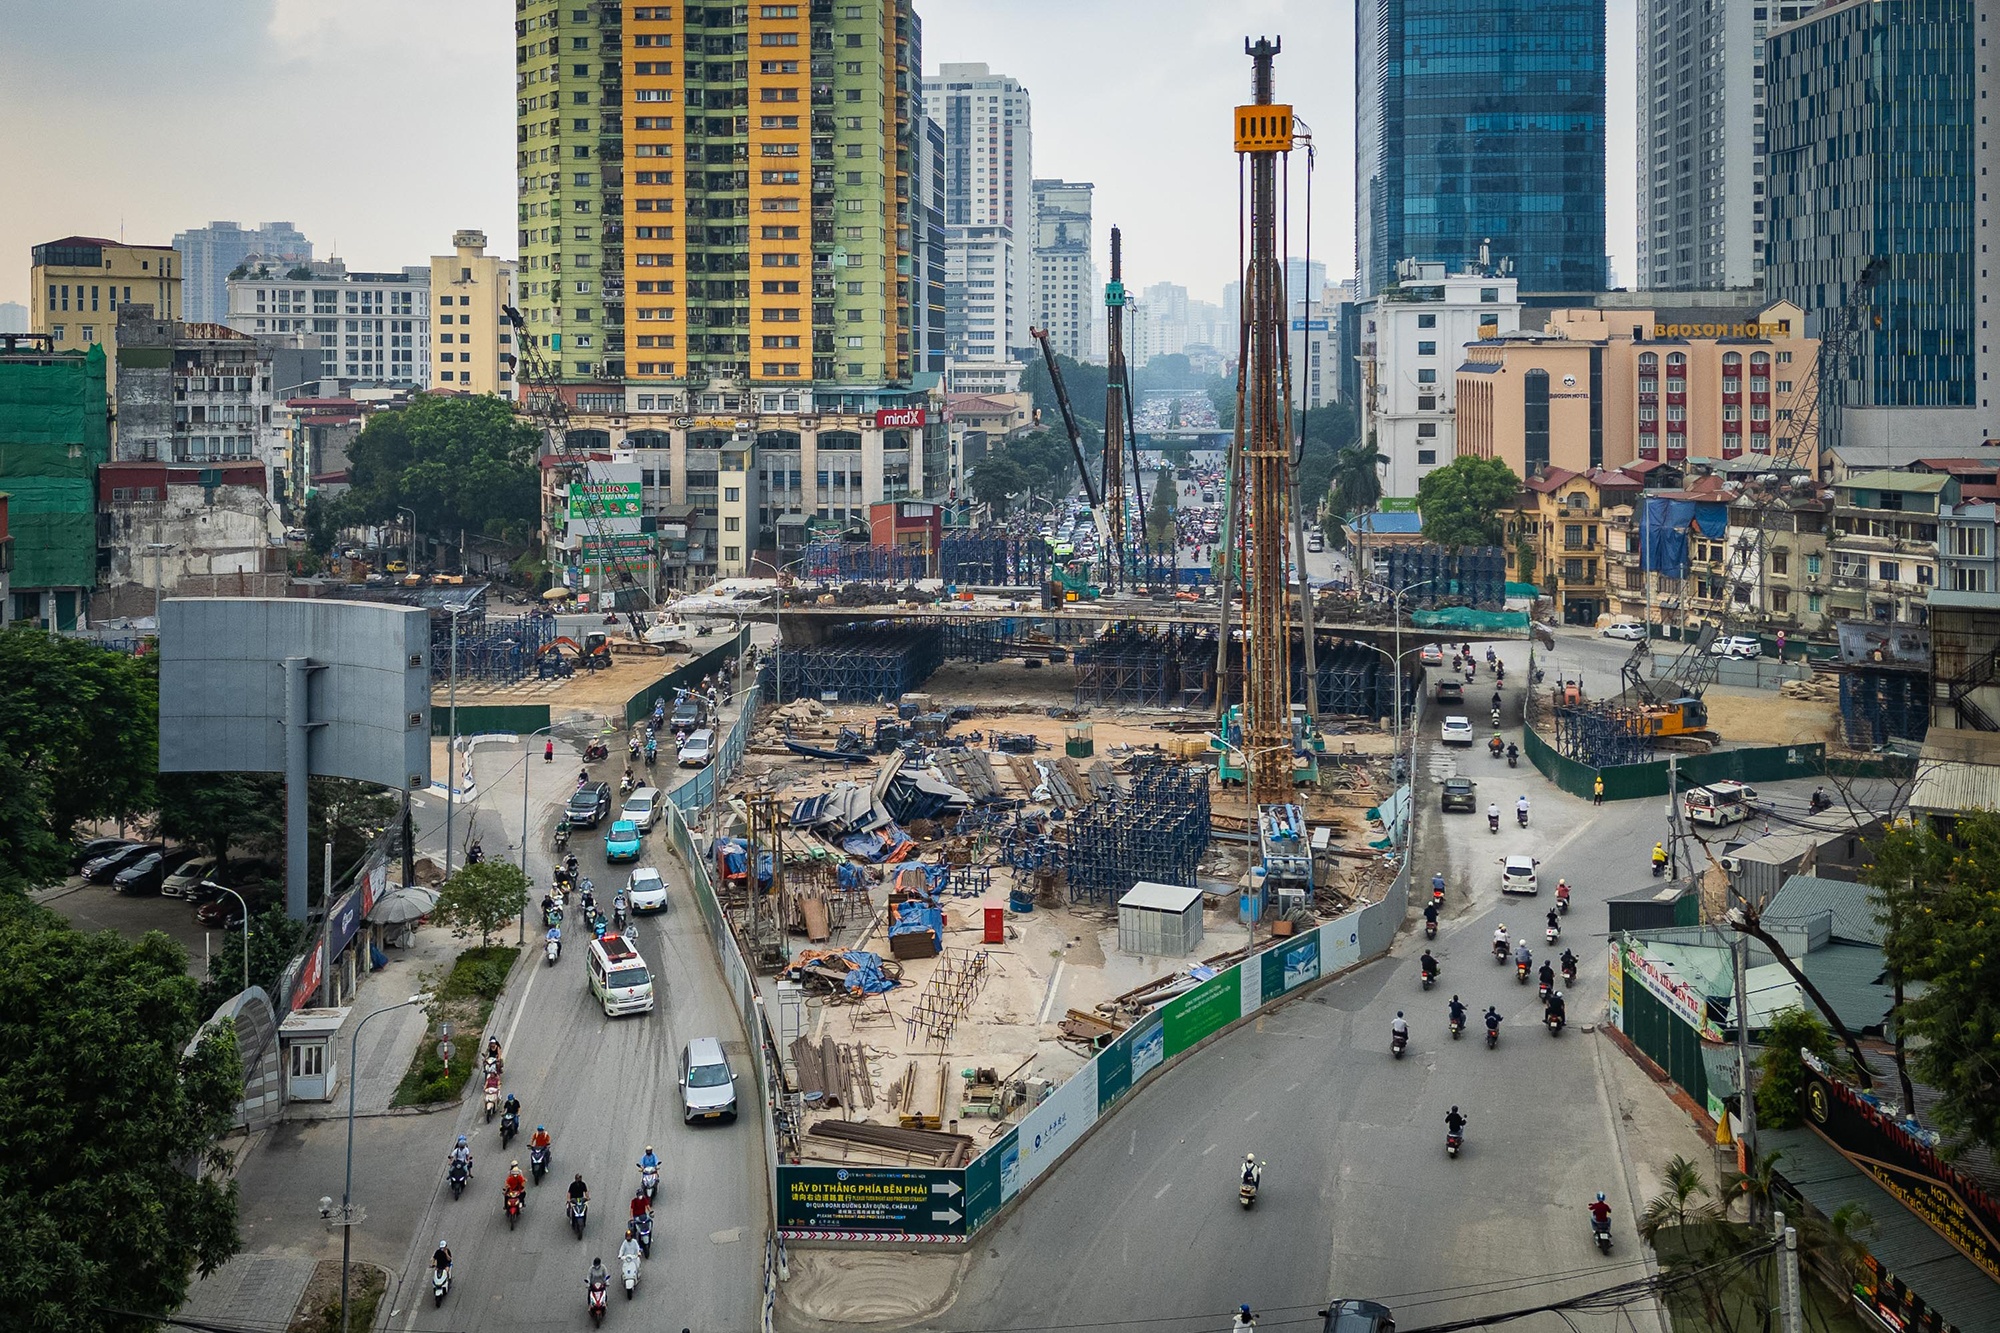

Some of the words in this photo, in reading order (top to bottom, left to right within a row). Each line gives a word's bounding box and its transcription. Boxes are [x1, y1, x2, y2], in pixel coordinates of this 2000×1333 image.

[1654, 323, 1728, 337] BAOSON
[1733, 323, 1790, 337] HOTEL
[884, 410, 918, 425] mindX
[791, 1182, 809, 1192] HÃY
[811, 1184, 822, 1192] ĐI
[824, 1182, 856, 1193] THẲNG
[858, 1183, 881, 1193] PHÍA
[883, 1184, 902, 1194] BÊN
[904, 1184, 927, 1195] PHẢI
[1931, 1185, 1965, 1219] HOTLINE
